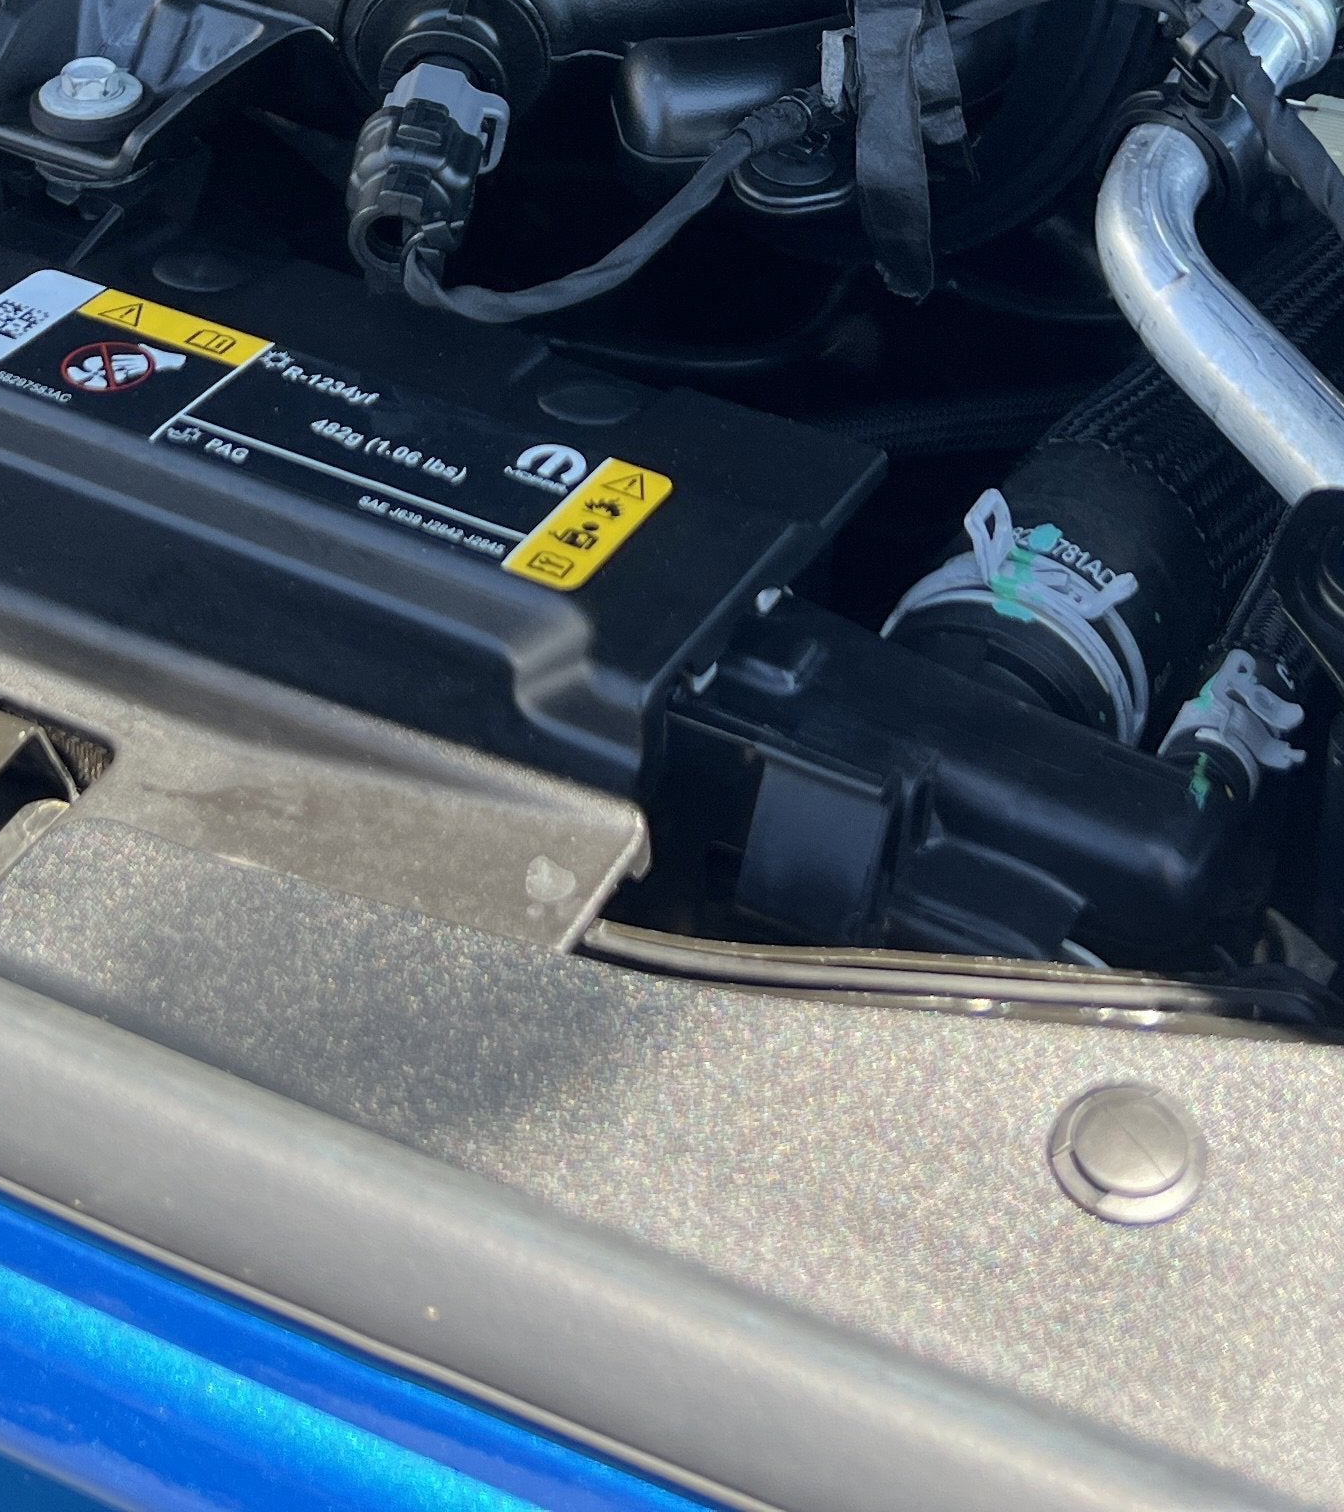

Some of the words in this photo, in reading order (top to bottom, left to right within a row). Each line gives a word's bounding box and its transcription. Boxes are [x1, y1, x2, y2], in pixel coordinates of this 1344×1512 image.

[281, 365, 381, 406] R-1234yf
[204, 438, 251, 465] PAG
[310, 418, 365, 449] 482g
[364, 437, 423, 468] (1.06
[421, 456, 468, 486] lbs)
